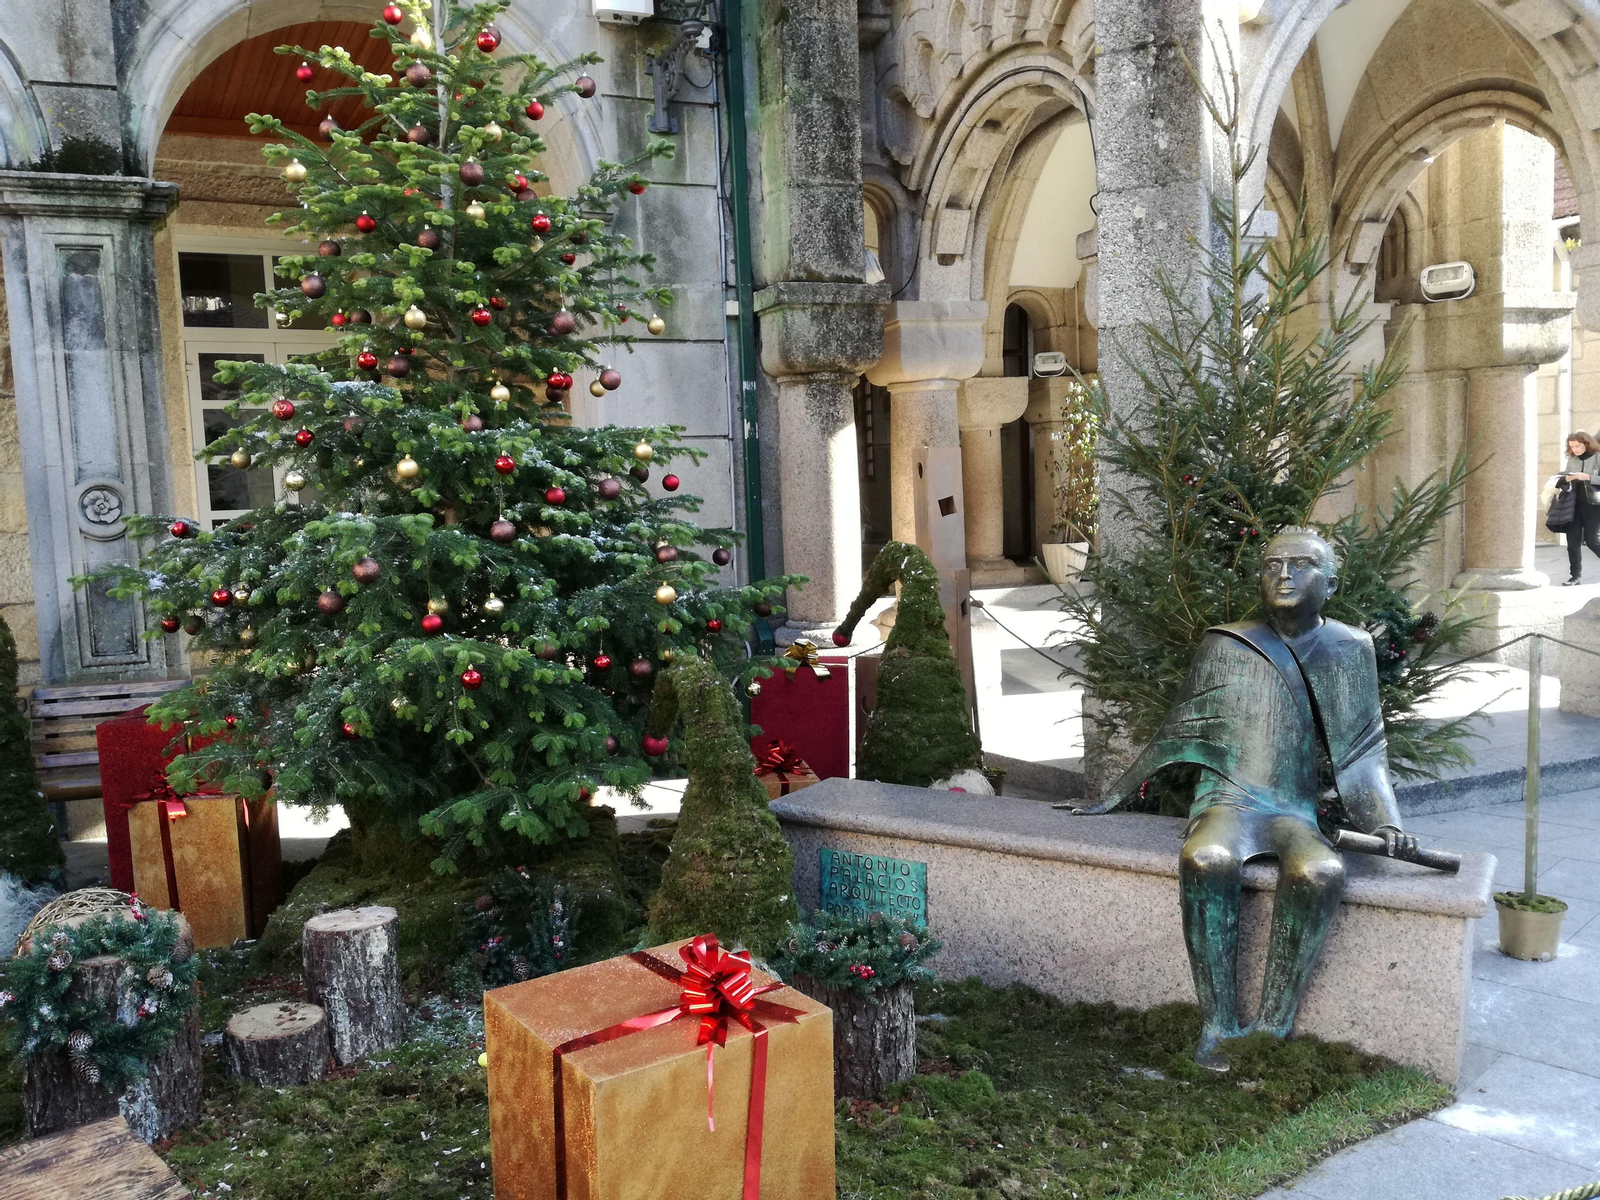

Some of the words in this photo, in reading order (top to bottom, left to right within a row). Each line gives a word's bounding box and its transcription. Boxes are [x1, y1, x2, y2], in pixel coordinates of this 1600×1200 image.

[831, 852, 910, 876] ANTONIO
[830, 866, 918, 893] PALACIOS
[829, 882, 921, 910] ARQUITECTO
[888, 908, 919, 922] 184
